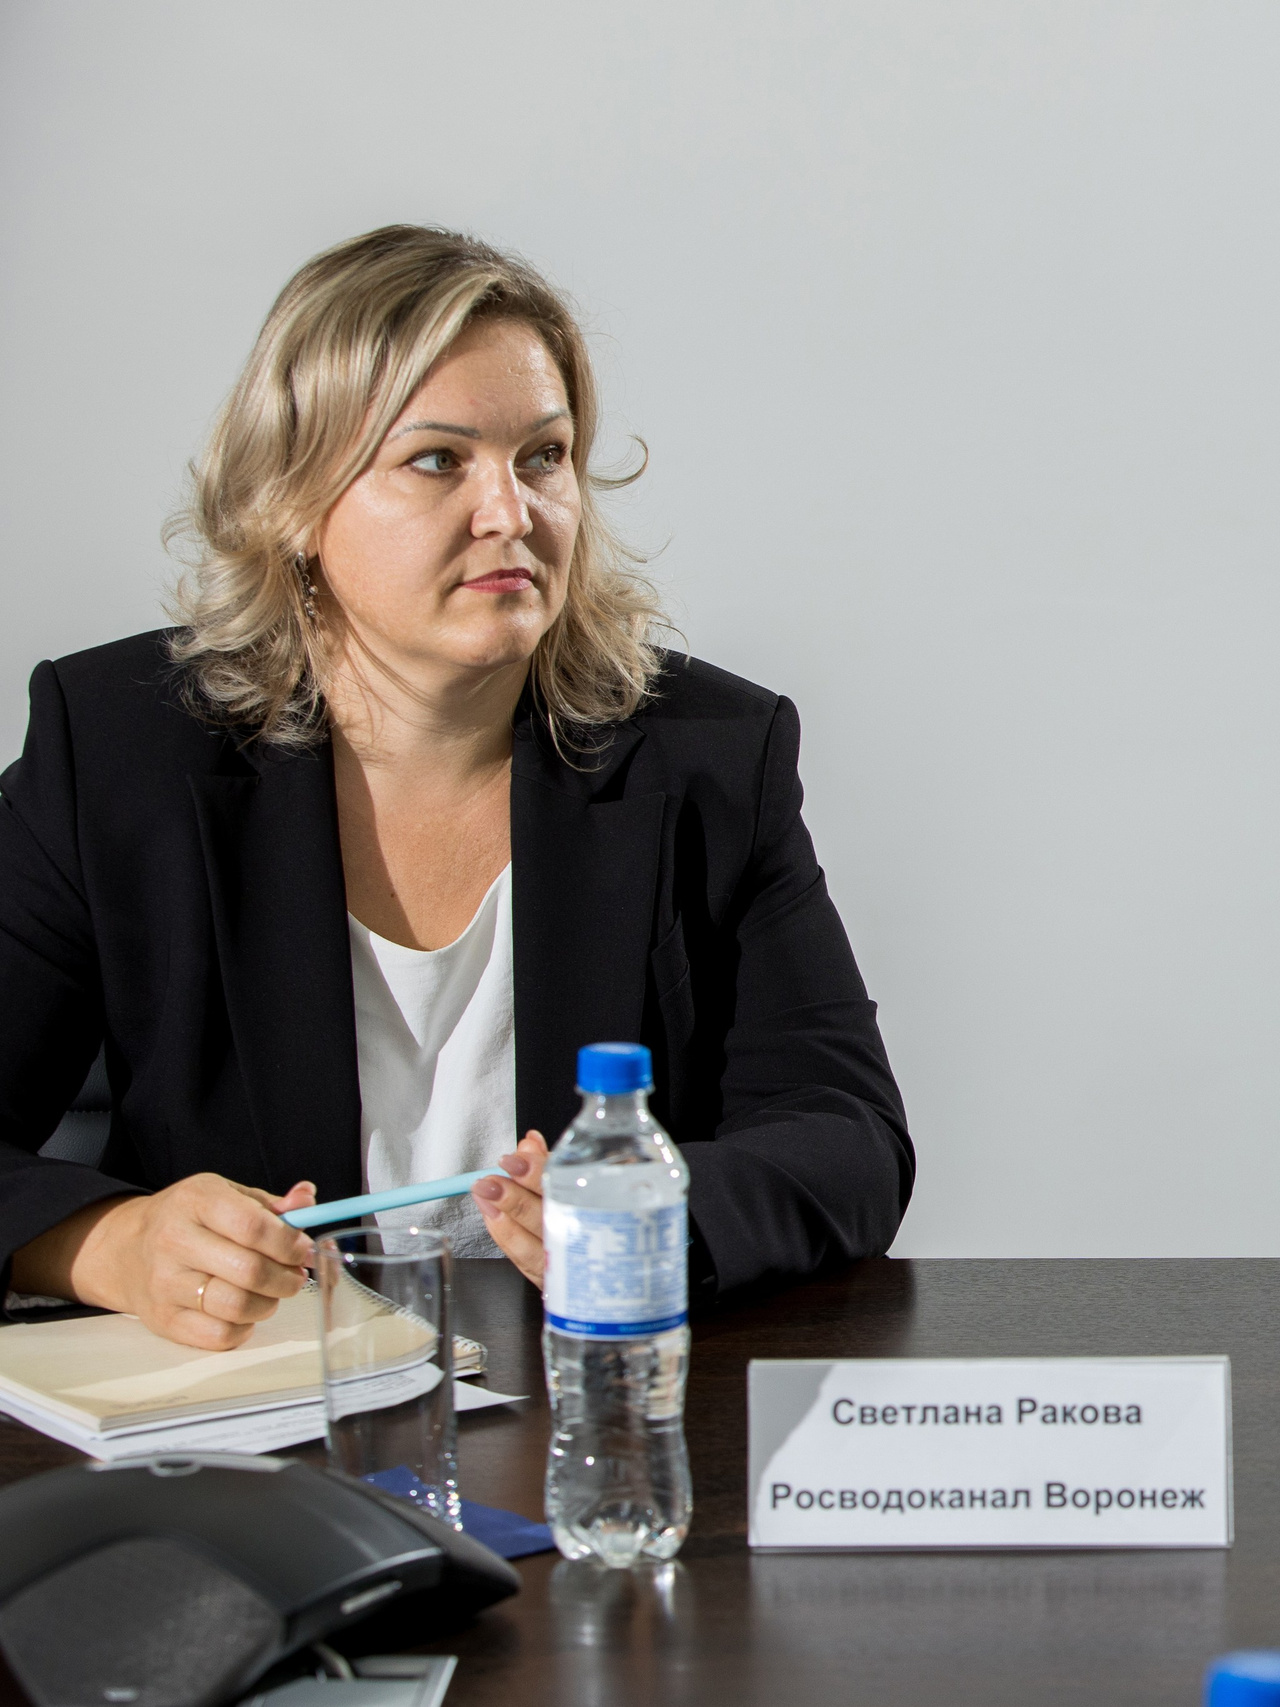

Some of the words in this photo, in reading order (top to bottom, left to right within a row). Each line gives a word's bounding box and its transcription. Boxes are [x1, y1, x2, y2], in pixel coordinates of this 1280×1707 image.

[833, 1399, 1002, 1425] Светлана
[1017, 1398, 1142, 1425] Ракова
[771, 1483, 1031, 1514] Росводоканал
[1045, 1482, 1205, 1516] Воронеж
